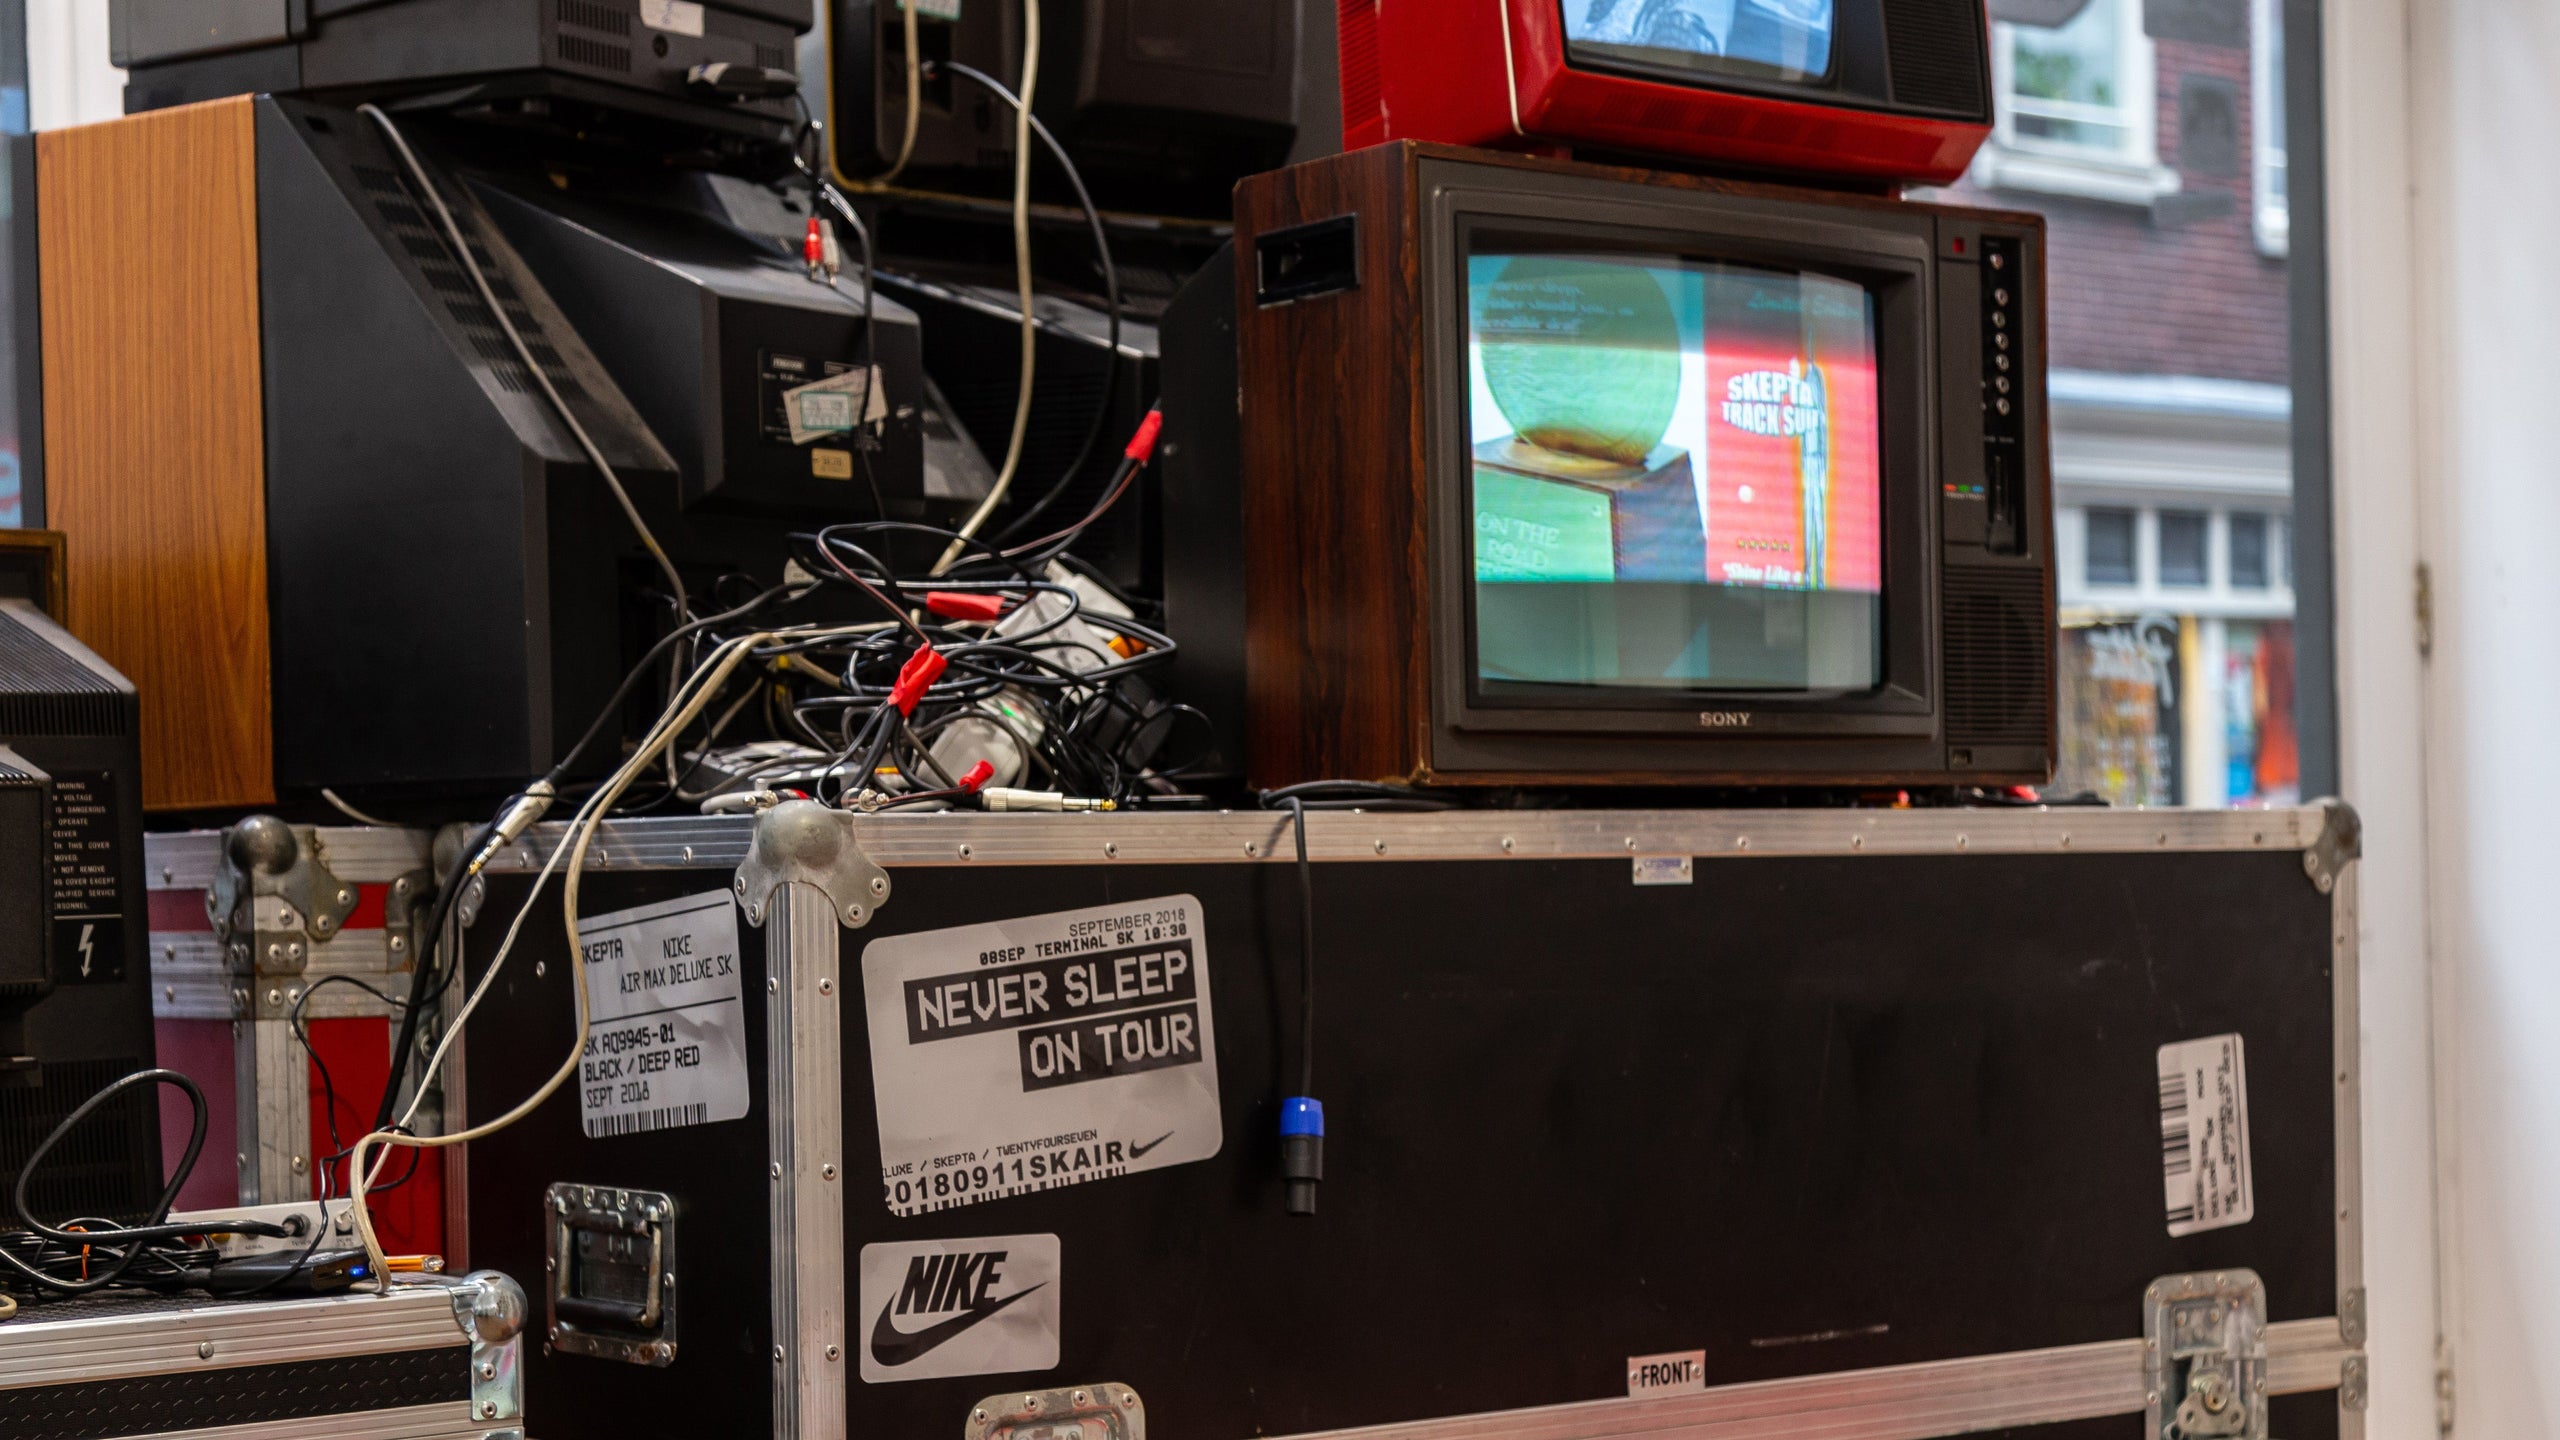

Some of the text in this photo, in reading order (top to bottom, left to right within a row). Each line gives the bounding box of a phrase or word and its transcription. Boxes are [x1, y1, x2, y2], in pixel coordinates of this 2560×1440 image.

[1727, 371, 1817, 408] SKEPTA
[1720, 401, 1780, 437] TRACK
[1700, 712, 1750, 726] SONY
[1035, 935, 1107, 958] TERMINAL
[1117, 931, 1135, 945] SK
[1144, 923, 1187, 941] 10:30
[1069, 908, 1185, 937] SEPTEMBER 2018
[663, 934, 692, 959] NIKE
[620, 954, 733, 995] AIR MAX DELUXE SK
[917, 949, 1188, 1031] NEVER SLEEP
[585, 1057, 624, 1082] BLACK
[639, 1049, 671, 1075] DEEP
[675, 1045, 700, 1067] RED
[1029, 1013, 1195, 1078] ON TOUR
[586, 1080, 650, 1109] SEPT 2018
[934, 1151, 976, 1169] SKEPTA
[996, 1128, 1098, 1158] TWENTYFOURSEVEN
[895, 1251, 1008, 1315] NIKE
[1641, 1360, 1692, 1388] FRONT
